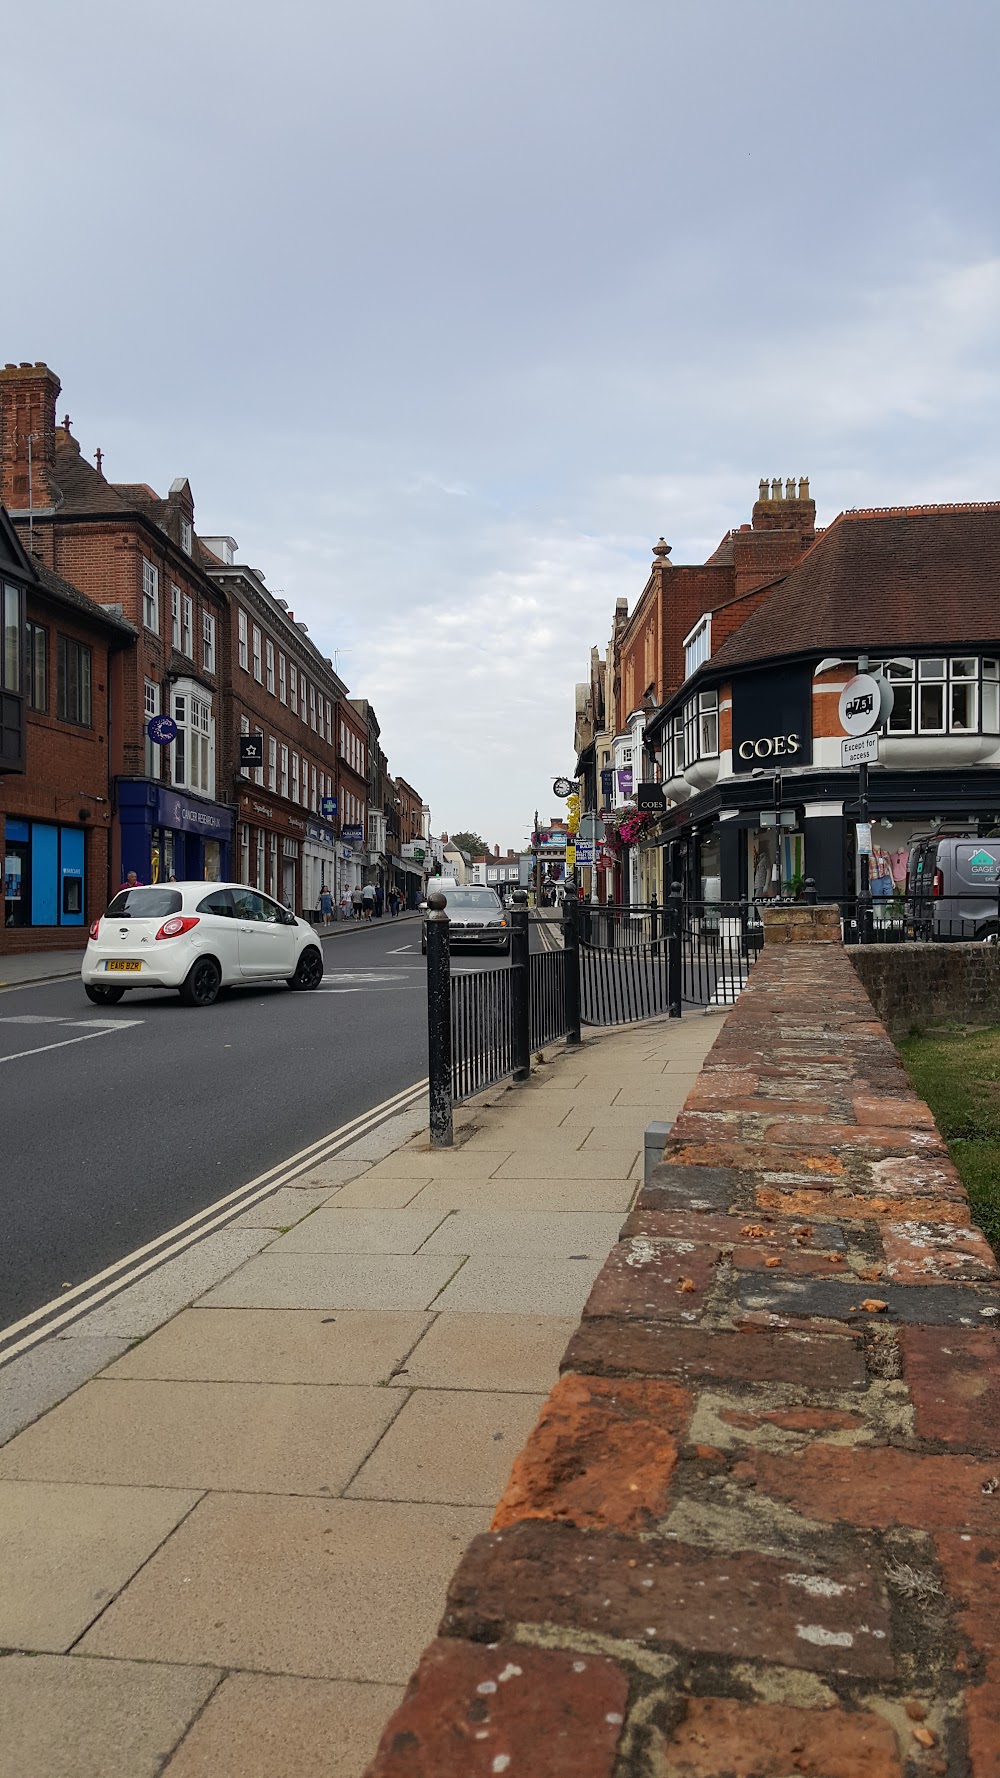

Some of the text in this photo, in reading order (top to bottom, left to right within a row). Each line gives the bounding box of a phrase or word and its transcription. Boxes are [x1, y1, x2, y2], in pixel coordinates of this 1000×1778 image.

[738, 733, 799, 760] COES
[844, 739, 876, 752] Except for
[849, 751, 870, 761] access
[641, 801, 663, 809] COES
[181, 808, 222, 828] CANCER RESEARCH UK
[971, 865, 994, 873] GAGE
